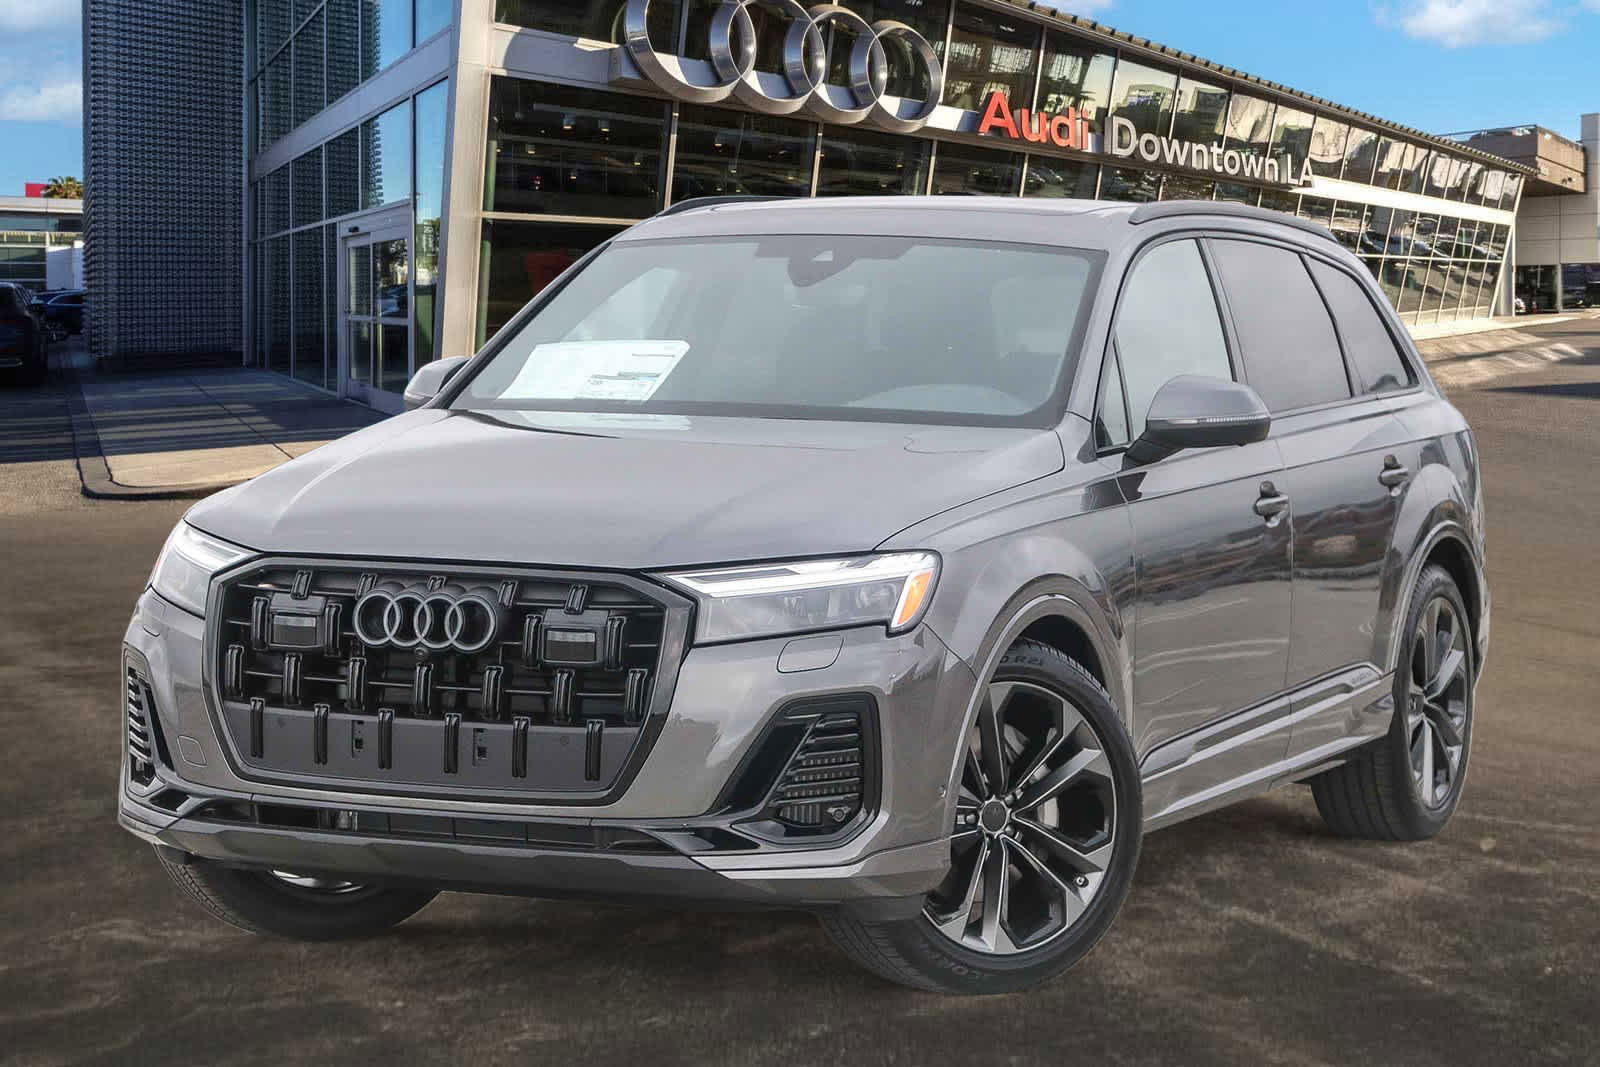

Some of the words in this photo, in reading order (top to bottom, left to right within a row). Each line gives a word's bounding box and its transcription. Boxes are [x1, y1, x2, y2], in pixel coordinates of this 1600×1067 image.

[977, 91, 1089, 149] Audi
[1107, 115, 1279, 183] Downtown
[1284, 153, 1314, 186] LA
